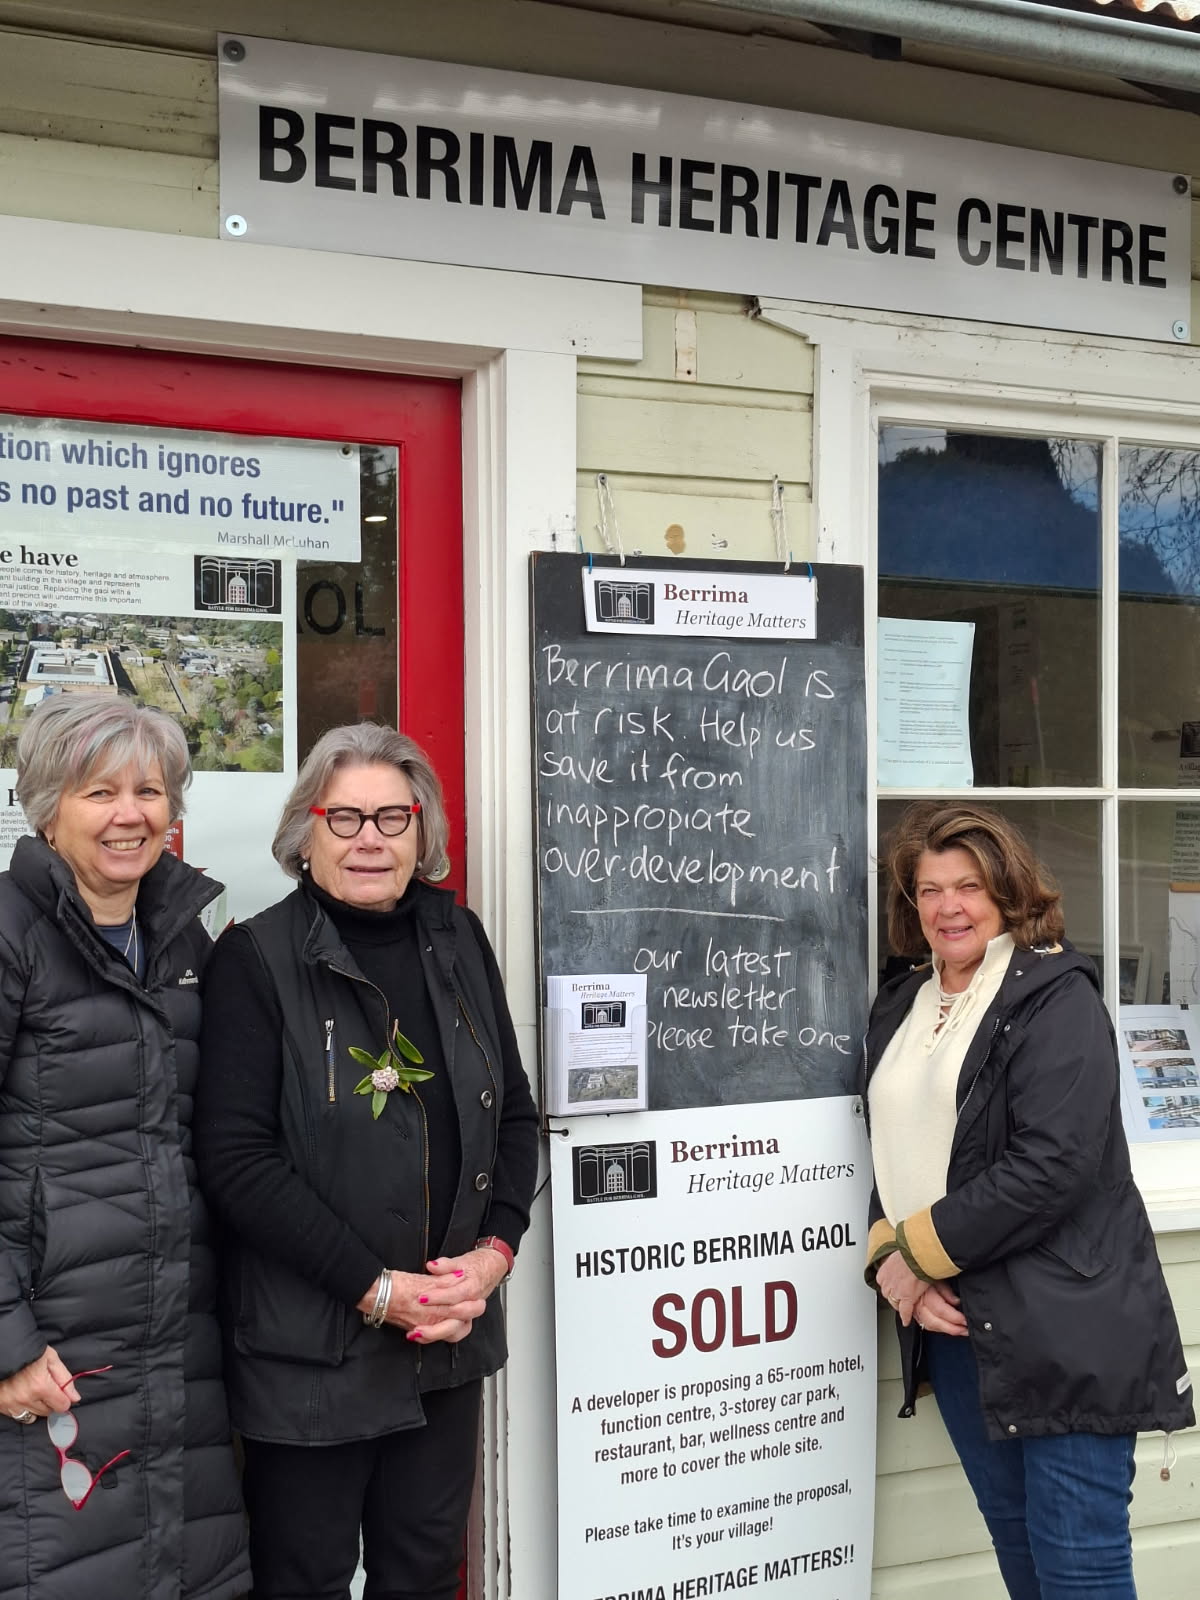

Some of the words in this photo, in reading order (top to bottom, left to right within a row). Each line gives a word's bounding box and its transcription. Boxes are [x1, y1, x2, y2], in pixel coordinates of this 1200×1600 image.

[259, 104, 606, 220] BERRIMA
[631, 152, 937, 260] HERITAGE
[957, 196, 1167, 289] CENTRE
[62, 439, 148, 471] which
[158, 445, 261, 478] ignores
[22, 483, 57, 506] no
[67, 484, 130, 513] past
[138, 489, 190, 516] and
[200, 495, 233, 518] no
[242, 493, 344, 525] future."
[20, 545, 79, 567] have
[217, 531, 270, 546] Marshall
[273, 535, 330, 549] McLuhan
[13, 575, 40, 583] building
[44, 585, 78, 593] Replacing
[84, 570, 111, 579] heritage
[664, 583, 750, 603] Berrima
[12, 592, 40, 600] precinct
[297, 580, 386, 636] OL
[676, 609, 744, 630] Heritage
[747, 613, 807, 629] Matters
[542, 644, 693, 691] Berrima
[703, 652, 787, 697] Gaol
[806, 660, 835, 699] is
[546, 700, 580, 735] at
[700, 706, 761, 760] Help
[775, 728, 816, 752] us
[630, 750, 650, 783] it
[660, 752, 743, 790] from
[706, 937, 792, 978] latest
[572, 981, 611, 992] Berrima
[663, 981, 796, 1011] newsletter
[728, 1015, 789, 1048] take
[798, 1027, 852, 1055] one
[670, 1134, 780, 1163] Berrima
[687, 1169, 775, 1194] Heritage
[779, 1162, 855, 1185] Matters
[576, 1241, 685, 1278] HISTORIC
[693, 1230, 795, 1265] BERRIMA
[801, 1223, 857, 1252] GAOL
[652, 1280, 798, 1359] SOLD
[572, 1397, 582, 1414] A
[587, 1388, 660, 1412] developer
[664, 1383, 677, 1400] is
[681, 1374, 751, 1401] proposing
[755, 1373, 763, 1386] a
[767, 1362, 825, 1385] 65-room
[828, 1355, 865, 1375] hotel,
[600, 1413, 662, 1436] function
[666, 1405, 715, 1429] centre,
[719, 1391, 776, 1417] 3-storey
[780, 1390, 802, 1407] car
[806, 1383, 840, 1406] park,
[594, 1437, 676, 1463] restaurant,
[680, 1432, 706, 1450] bar,
[710, 1420, 770, 1444] wellness
[774, 1412, 817, 1434] centre
[820, 1406, 845, 1425] and
[621, 1464, 658, 1485] more
[663, 1460, 677, 1477] to
[681, 1454, 720, 1475] cover
[724, 1449, 746, 1466] the
[750, 1439, 791, 1461] whole
[795, 1435, 823, 1455] site.
[585, 1523, 630, 1544] Please
[634, 1517, 663, 1534] take
[667, 1511, 696, 1528] time
[700, 1507, 713, 1521] to
[716, 1496, 770, 1519] examine
[773, 1491, 793, 1507] the
[796, 1478, 852, 1506] proposal,
[672, 1533, 692, 1551] It's
[696, 1527, 725, 1549] your
[728, 1516, 774, 1540] village!
[672, 1564, 759, 1600] HERITAGE
[764, 1544, 855, 1583] MATTERS!!
